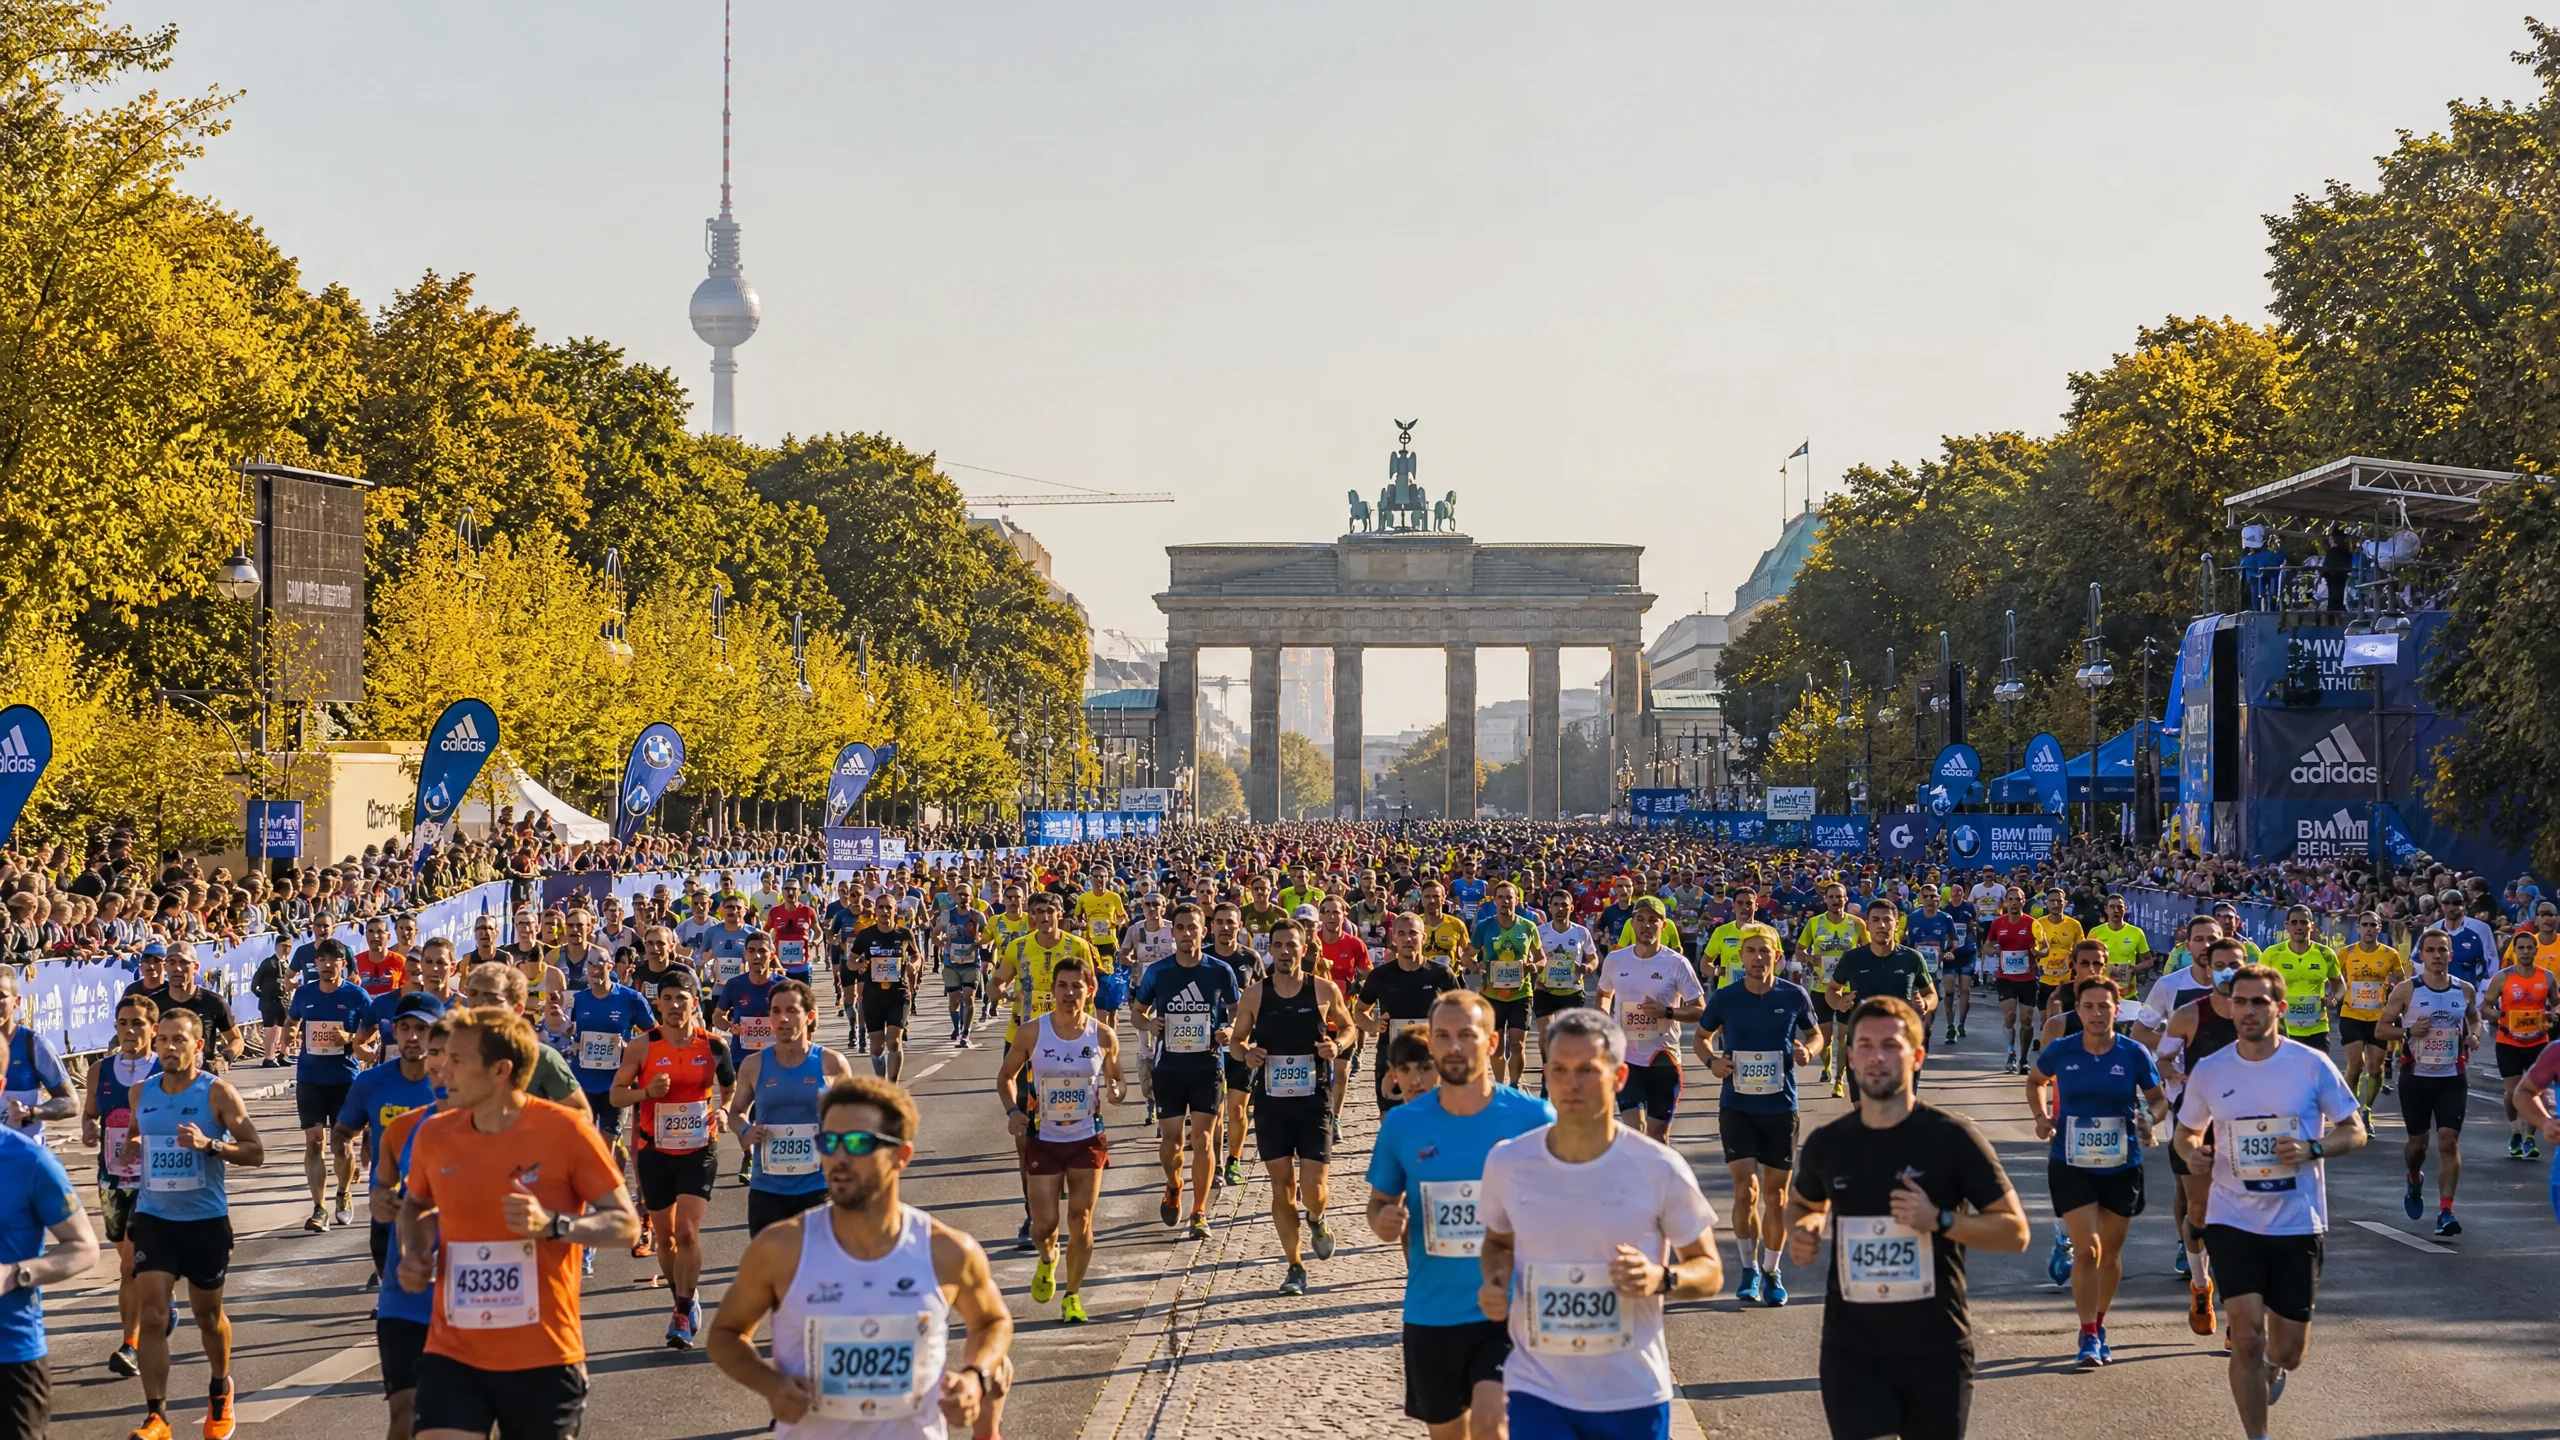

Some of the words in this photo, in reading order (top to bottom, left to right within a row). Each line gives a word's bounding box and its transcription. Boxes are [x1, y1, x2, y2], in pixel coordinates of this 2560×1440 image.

[440, 737, 486, 752] adidas
[0, 755, 36, 773] didas
[2290, 759, 2378, 784] adidas
[1991, 828, 2026, 841] BMW
[1851, 1237, 1917, 1268] 45425
[456, 1266, 520, 1295] 43336
[1543, 1291, 1617, 1318] 23630
[829, 1347, 912, 1377] 30825
